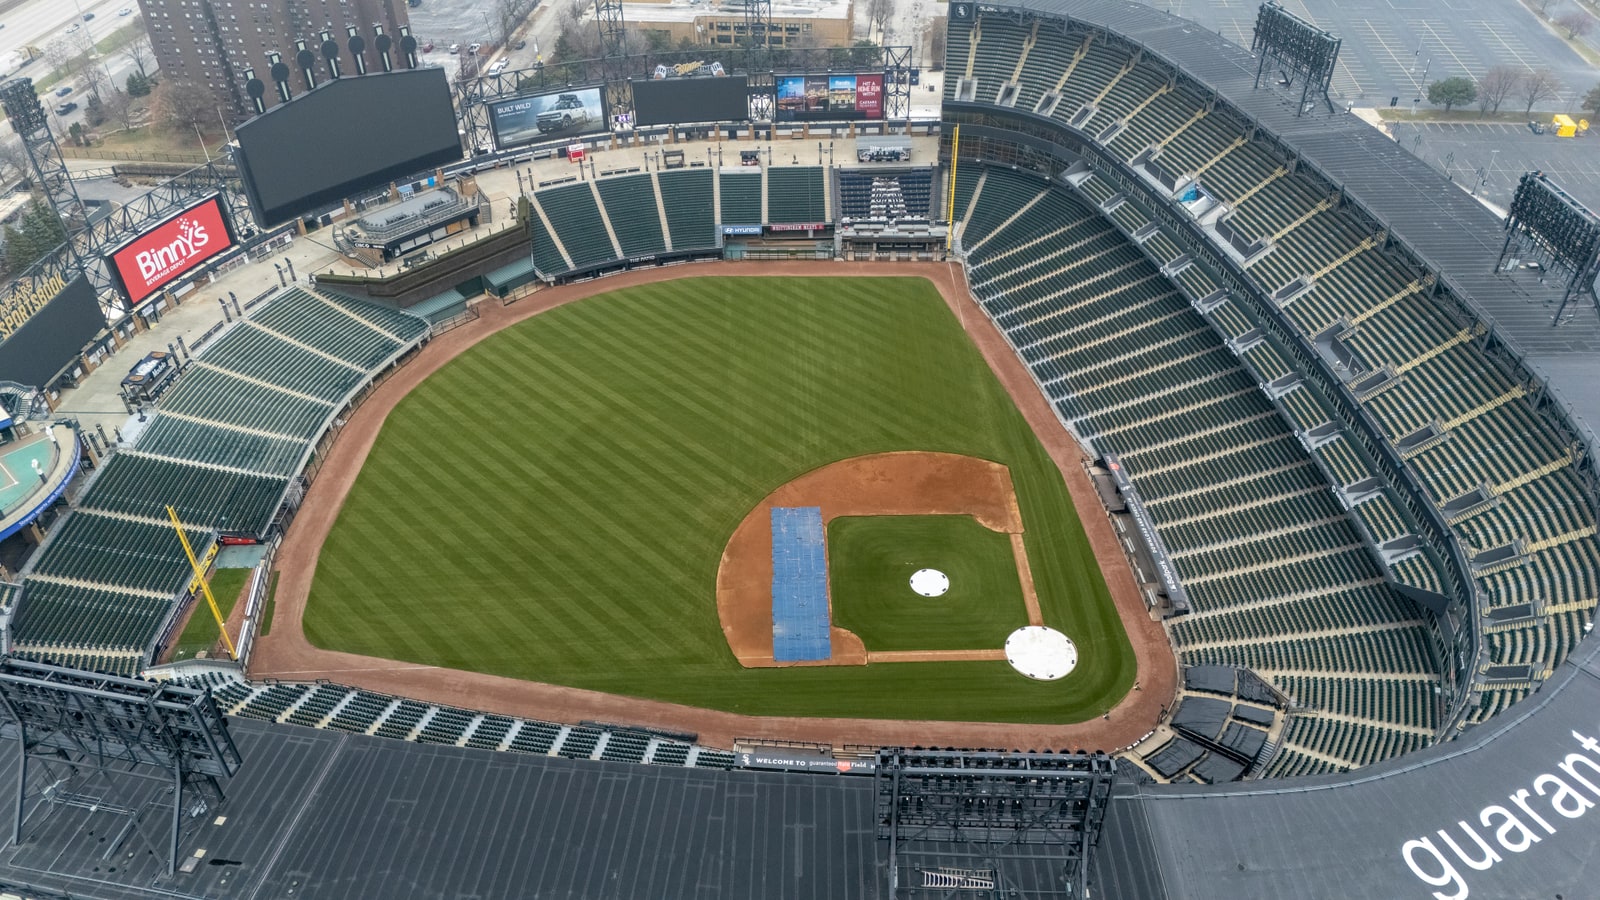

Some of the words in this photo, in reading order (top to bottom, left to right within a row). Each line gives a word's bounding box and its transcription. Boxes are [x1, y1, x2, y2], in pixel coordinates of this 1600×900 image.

[497, 106, 514, 114] BUILT
[515, 102, 531, 111] WILD
[146, 266, 171, 287] BEVERAGE
[170, 259, 186, 273] DEPOT
[1142, 527, 1157, 554] DOWNLOAD
[1159, 560, 1174, 586] Ballpark
[756, 758, 793, 766] WELCOME
[851, 761, 867, 769] Field
